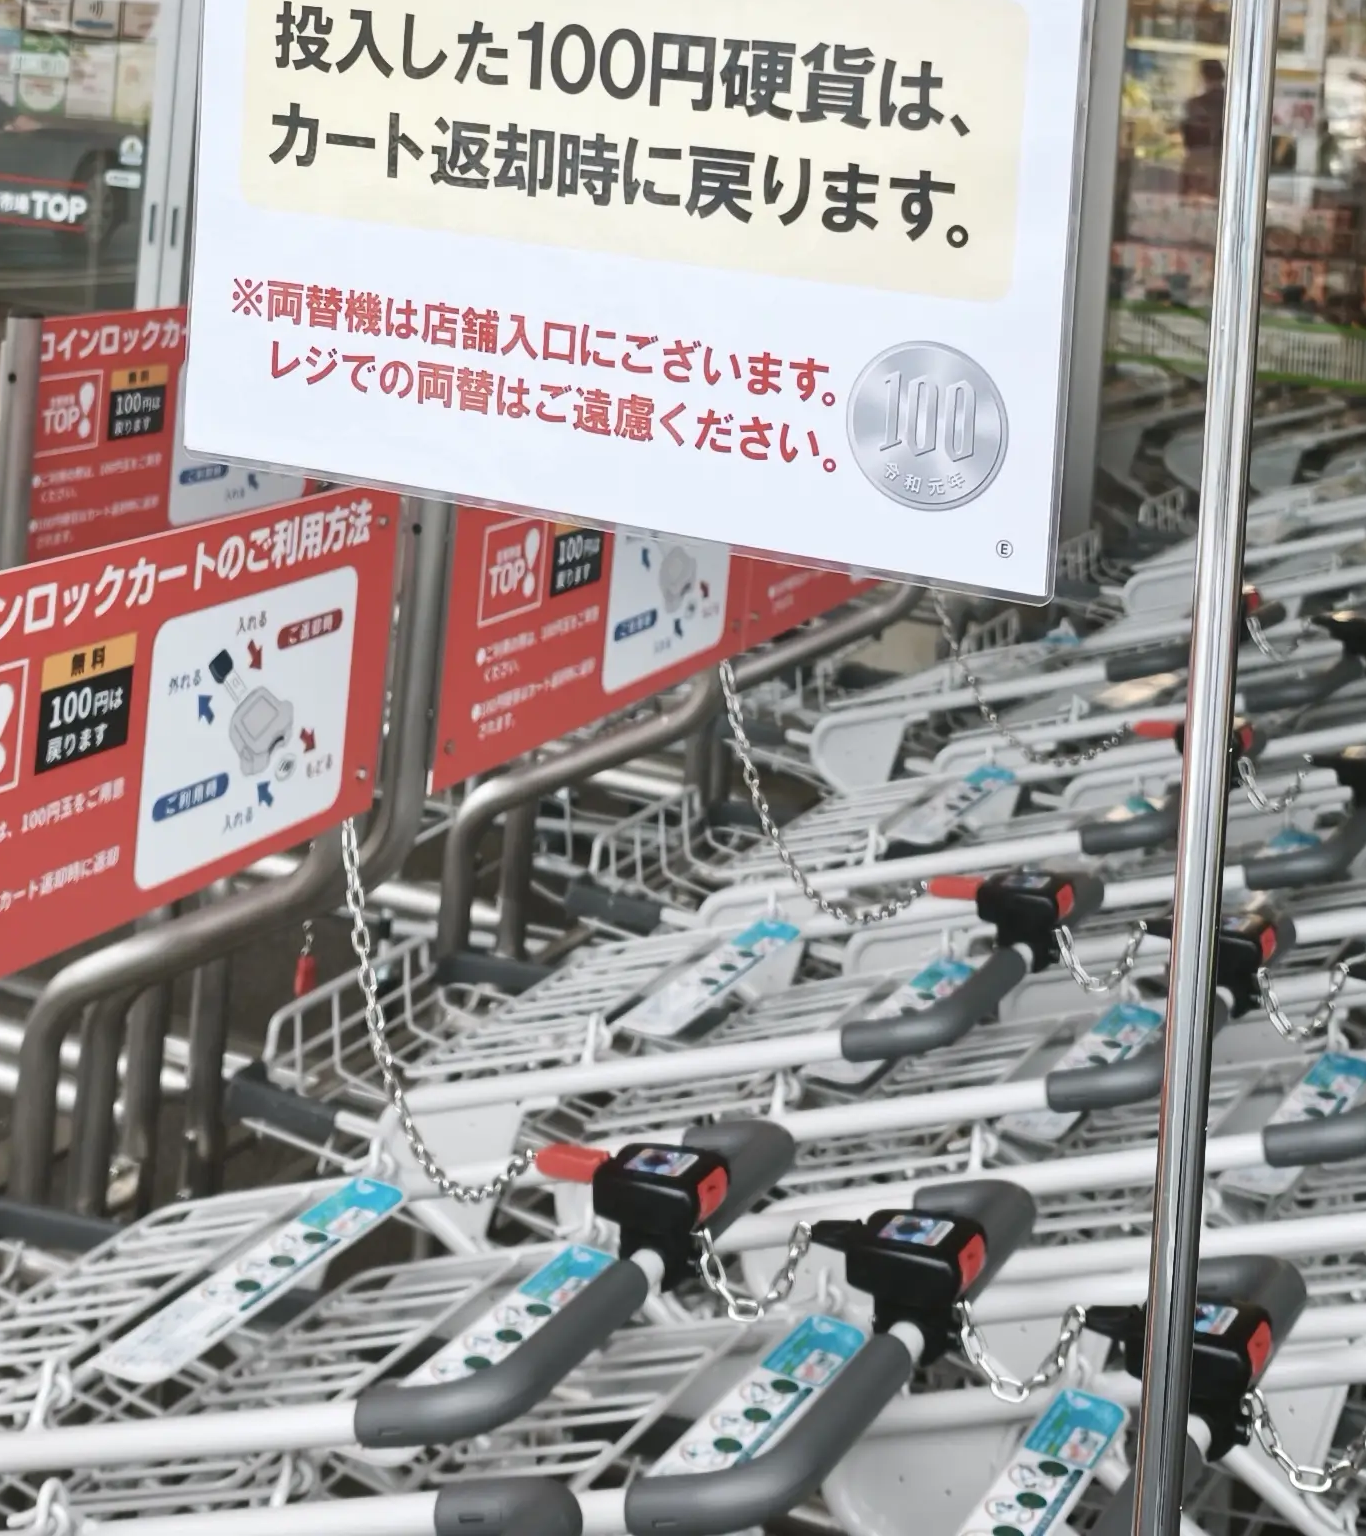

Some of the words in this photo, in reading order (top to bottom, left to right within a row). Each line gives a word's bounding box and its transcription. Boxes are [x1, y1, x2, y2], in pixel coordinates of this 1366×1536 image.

[274, 2, 970, 137] 投入した100円硬貨は、
[31, 190, 87, 224] TOP
[269, 102, 969, 248] カート返却時に戻ります。
[232, 278, 836, 407] ※両替機は店舗入口にございます。
[269, 340, 837, 473] レジでの両替はご遠慮ください。
[880, 371, 976, 462] 100
[885, 463, 966, 495] 令和元年
[45, 722, 108, 764] 戻ります
[49, 686, 124, 729] 100円は
